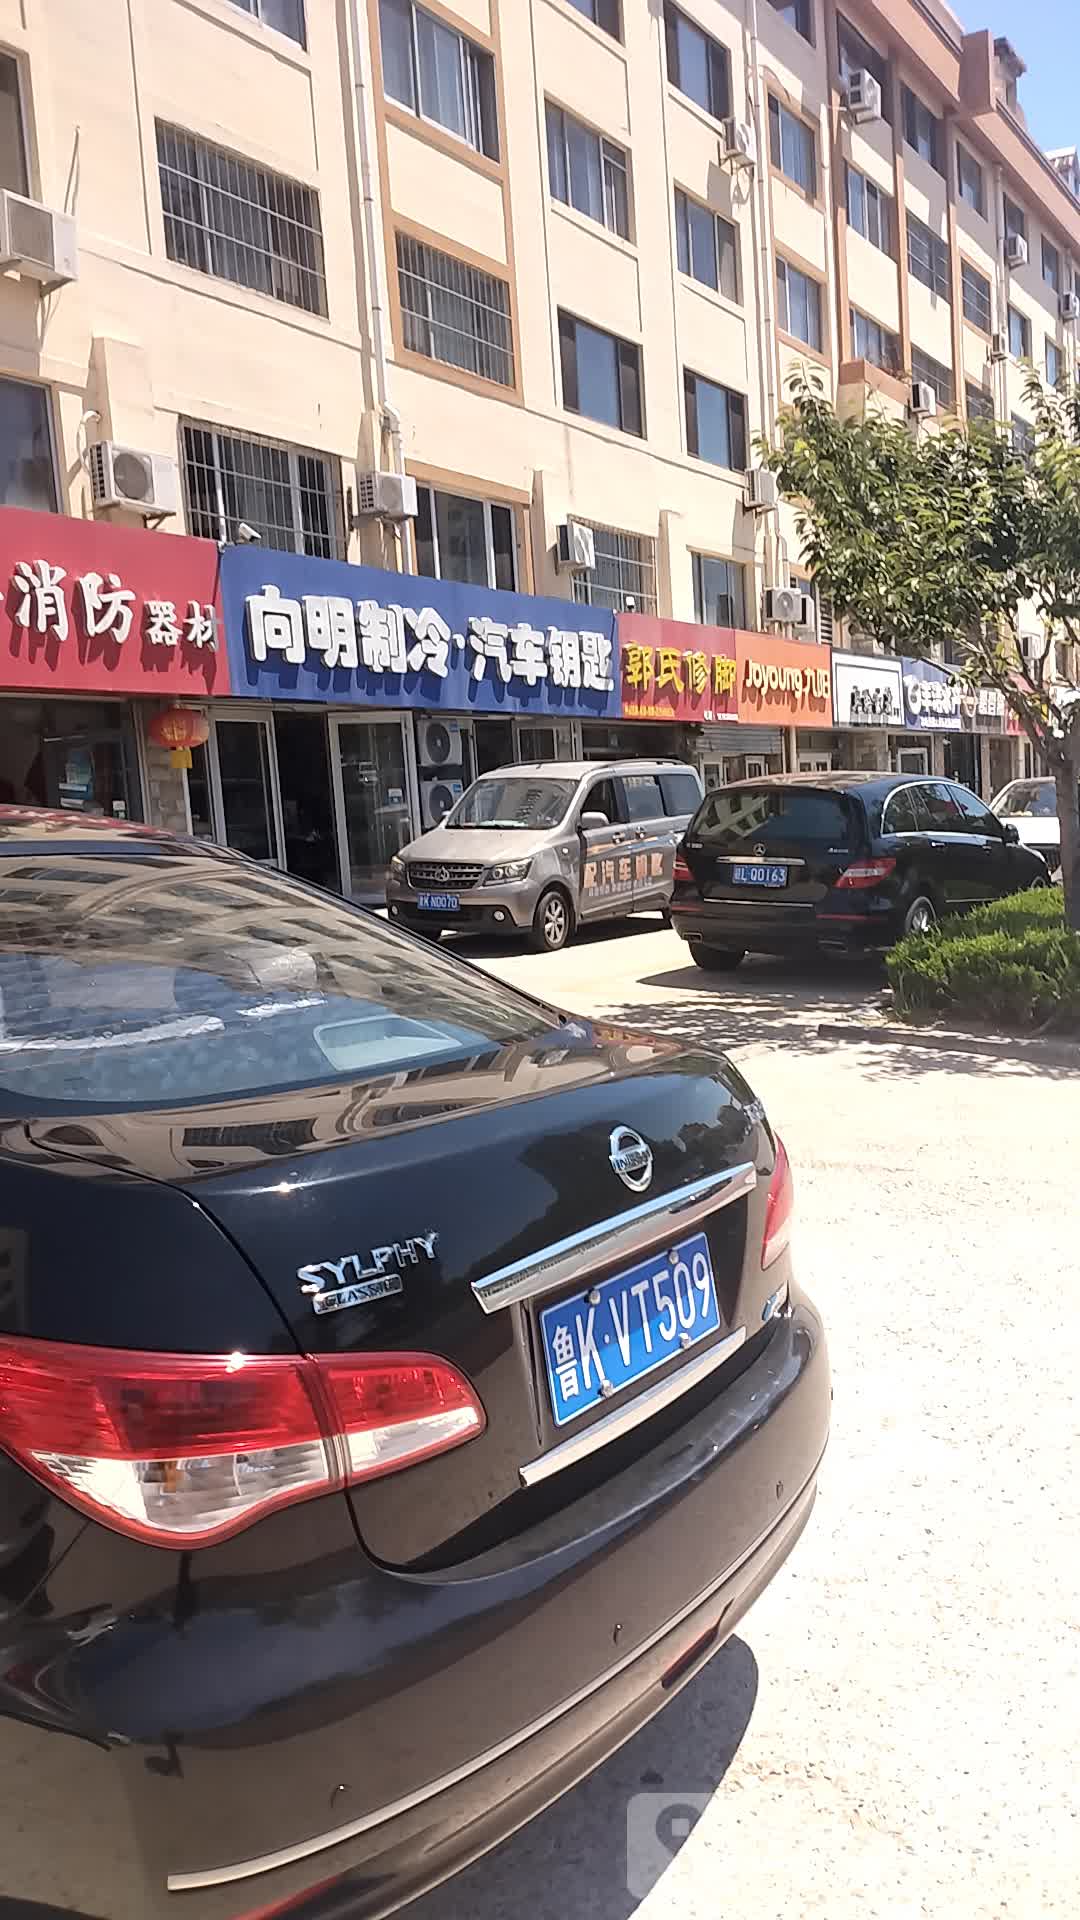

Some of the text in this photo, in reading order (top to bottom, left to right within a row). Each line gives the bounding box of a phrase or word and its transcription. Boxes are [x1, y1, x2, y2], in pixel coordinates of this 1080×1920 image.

[0, 559, 218, 652] 消防器材
[622, 640, 737, 699] 郭氏修脚
[297, 1230, 440, 1293] SYLPHY
